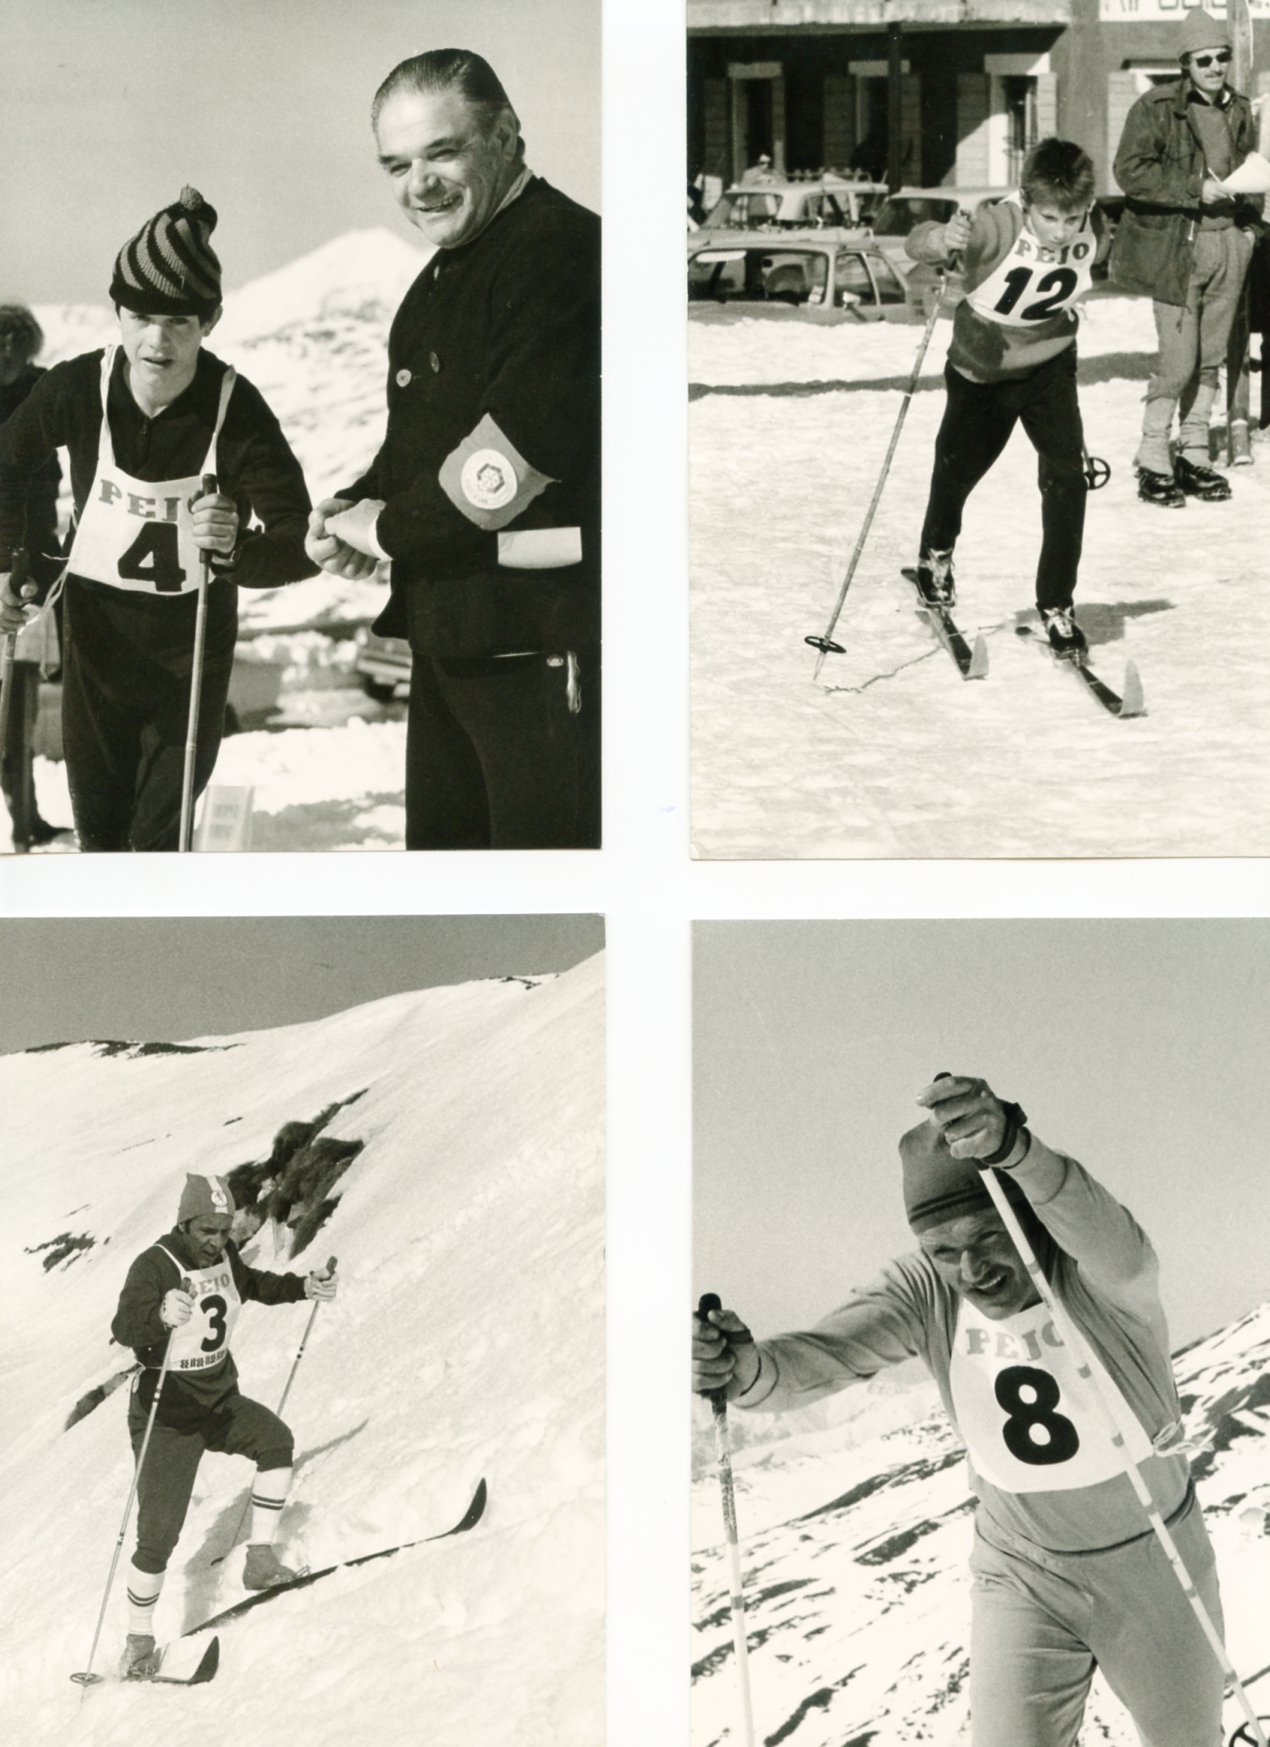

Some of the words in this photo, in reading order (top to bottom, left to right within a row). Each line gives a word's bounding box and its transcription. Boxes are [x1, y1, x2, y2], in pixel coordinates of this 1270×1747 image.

[993, 266, 1078, 321] 12
[98, 478, 197, 522] PEJ
[117, 521, 187, 592] 4
[200, 1294, 227, 1352] 3
[994, 1365, 1080, 1466] 8
